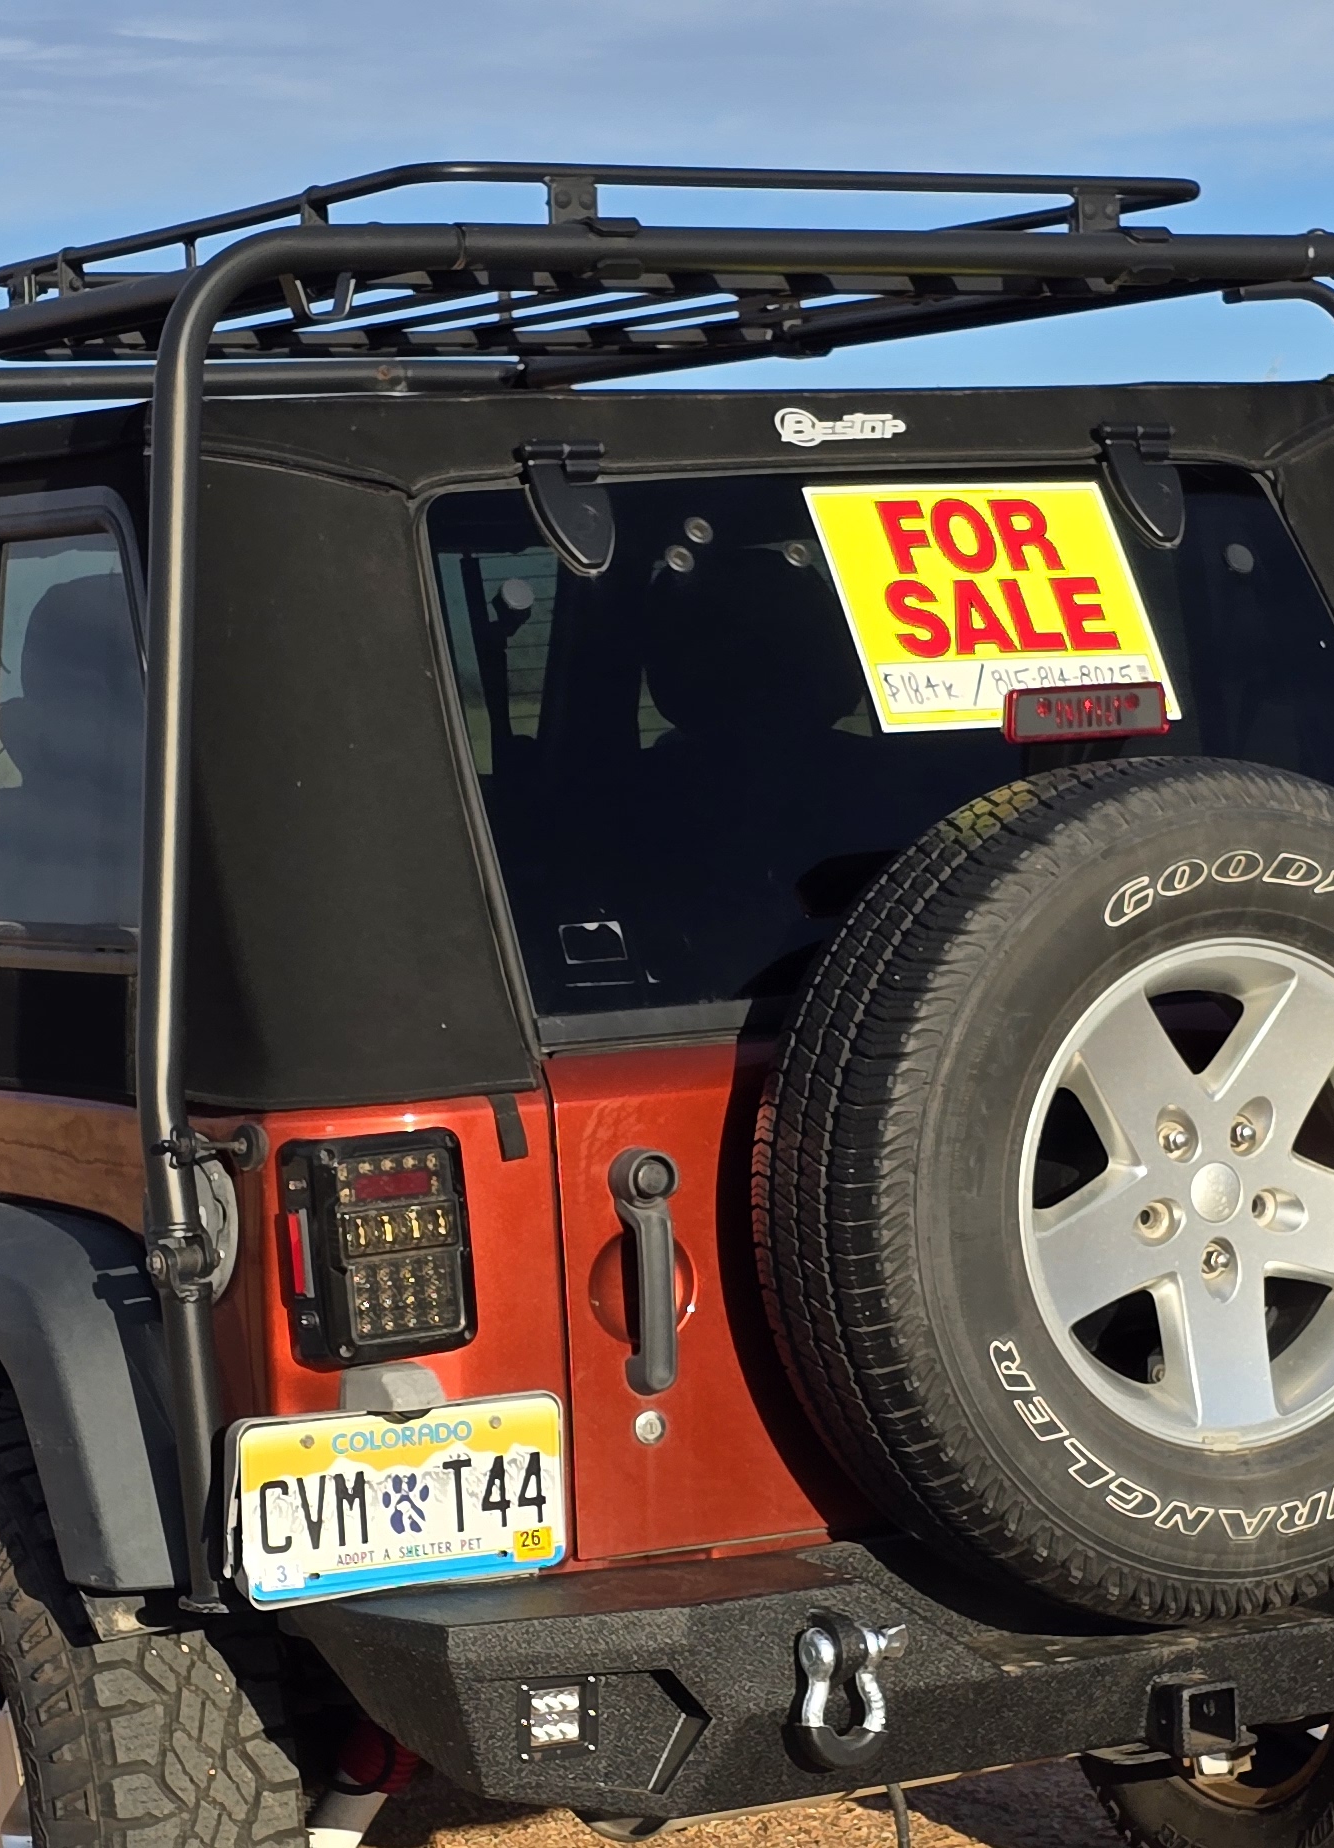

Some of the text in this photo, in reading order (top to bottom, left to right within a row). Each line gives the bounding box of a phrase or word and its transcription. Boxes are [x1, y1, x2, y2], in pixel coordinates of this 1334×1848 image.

[874, 498, 1066, 574] FOR
[884, 576, 1121, 658] SALE
[331, 1420, 473, 1455] COLORADO
[259, 1451, 547, 1555] CVM T44
[337, 1537, 482, 1567] ADOPT A SHELTER PET
[520, 1529, 541, 1548] 26
[276, 1565, 288, 1583] 3
